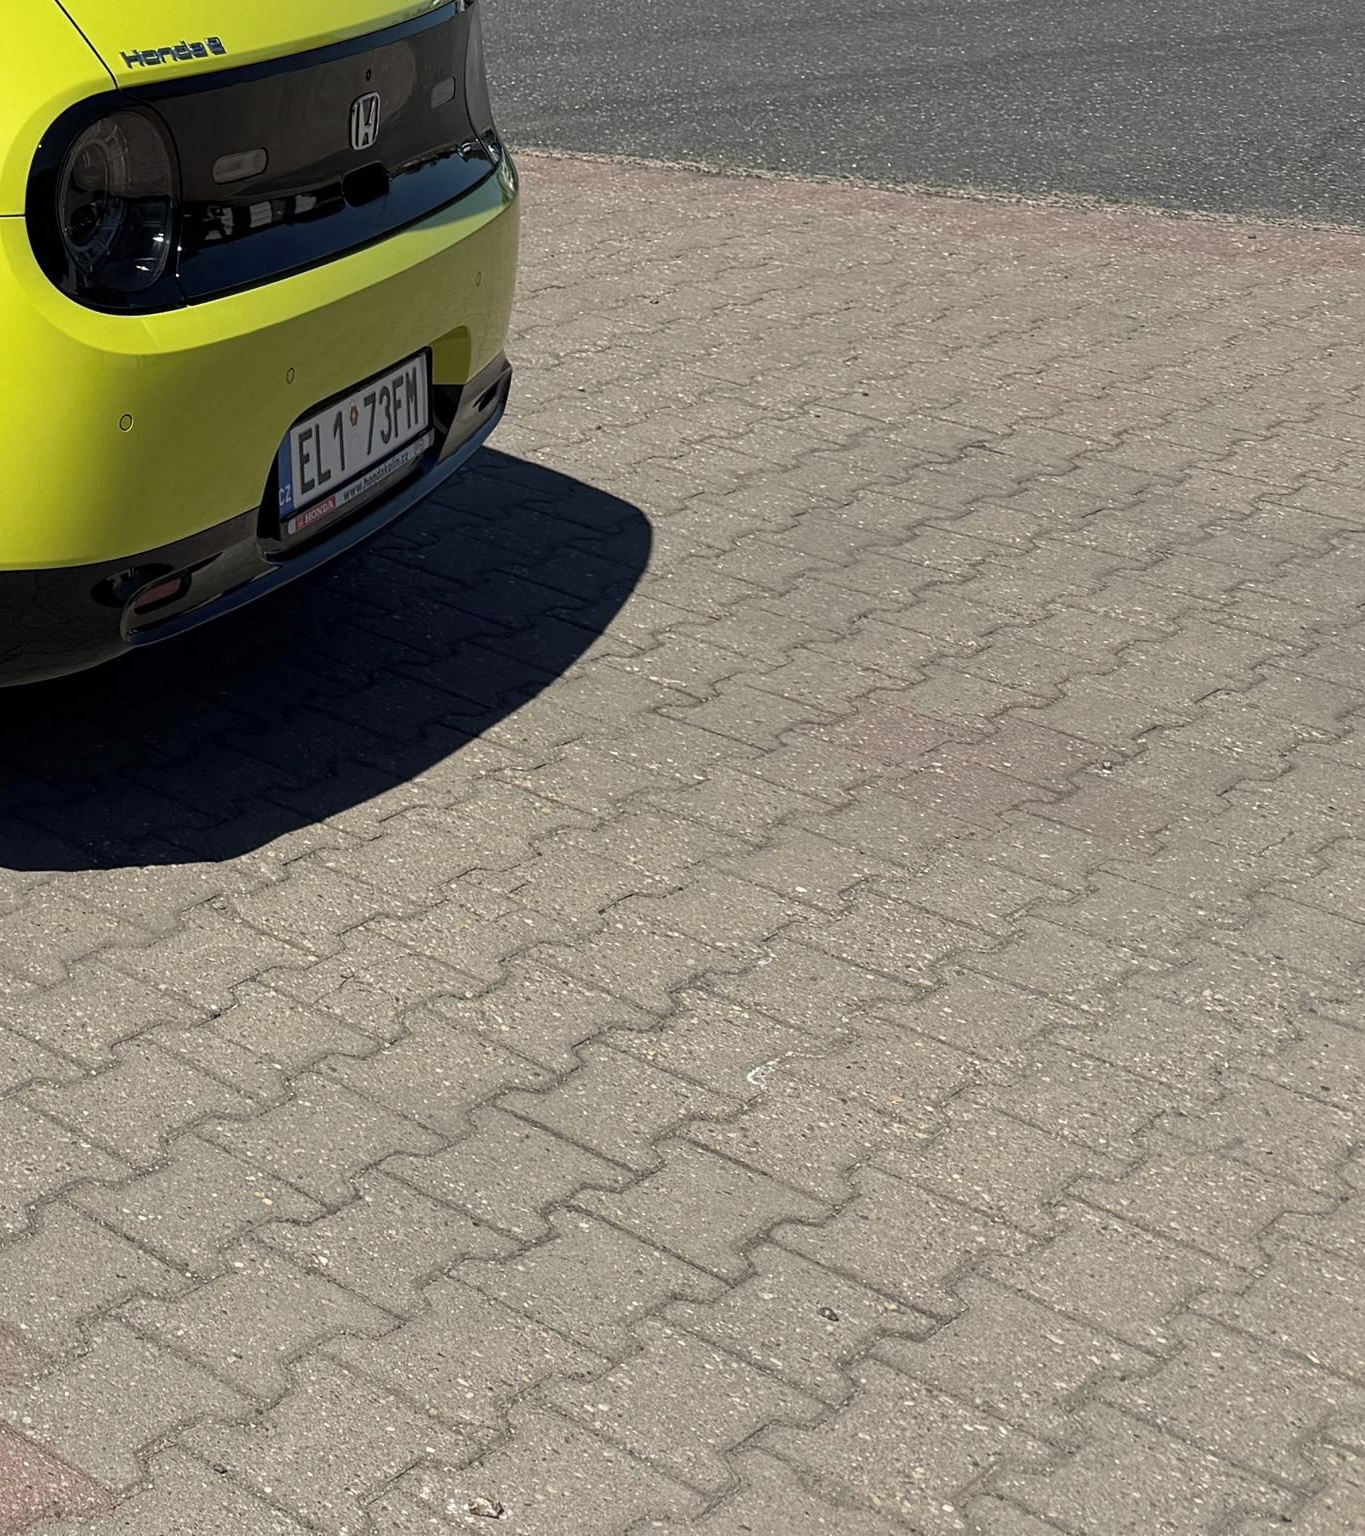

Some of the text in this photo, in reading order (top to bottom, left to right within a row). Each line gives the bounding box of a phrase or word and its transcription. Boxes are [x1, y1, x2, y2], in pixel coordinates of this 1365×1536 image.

[119, 40, 209, 69] Honda
[298, 366, 419, 495] EL1 73FM
[278, 484, 293, 506] CZ
[305, 499, 336, 524] HONDA
